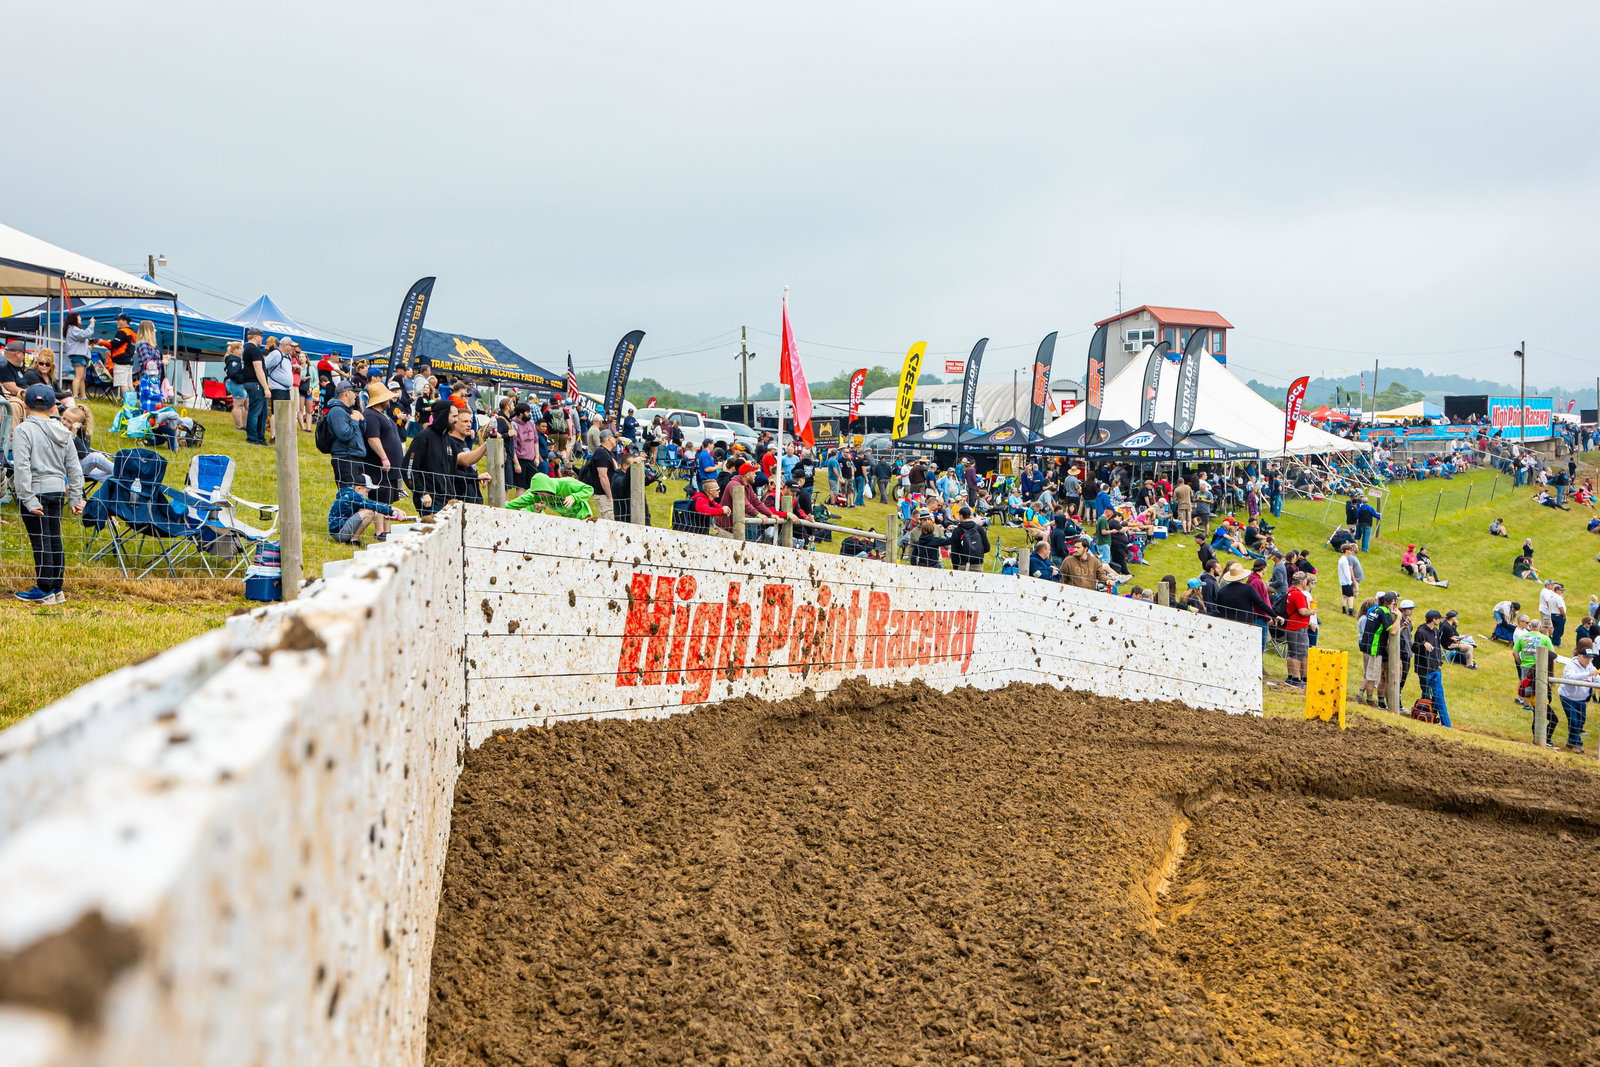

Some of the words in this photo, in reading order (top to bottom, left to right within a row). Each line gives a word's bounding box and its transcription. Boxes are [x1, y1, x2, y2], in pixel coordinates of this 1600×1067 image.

[64, 271, 116, 287] FACTORY
[117, 282, 157, 295] RACING
[411, 294, 425, 321] STEEL
[401, 318, 410, 338] STEEL
[406, 323, 418, 344] CITY
[396, 338, 404, 358] BACK
[622, 343, 635, 367] STEEL
[430, 359, 453, 370] TRAIN
[454, 362, 483, 375] HARDER
[490, 369, 520, 380] RECOVER
[520, 373, 545, 384] FASTER
[618, 368, 626, 384] CITY
[1152, 355, 1162, 388] BATTERY
[855, 385, 863, 404] CLUB
[966, 360, 977, 416] DUNLOP
[1182, 354, 1193, 420] DUNLOP
[1292, 398, 1303, 421] CLUB
[1491, 405, 1507, 428] High
[1507, 405, 1523, 427] Poin
[1525, 406, 1551, 429] Raceway
[616, 572, 751, 705] High
[753, 584, 862, 679] Point
[863, 591, 979, 674] Raceway
